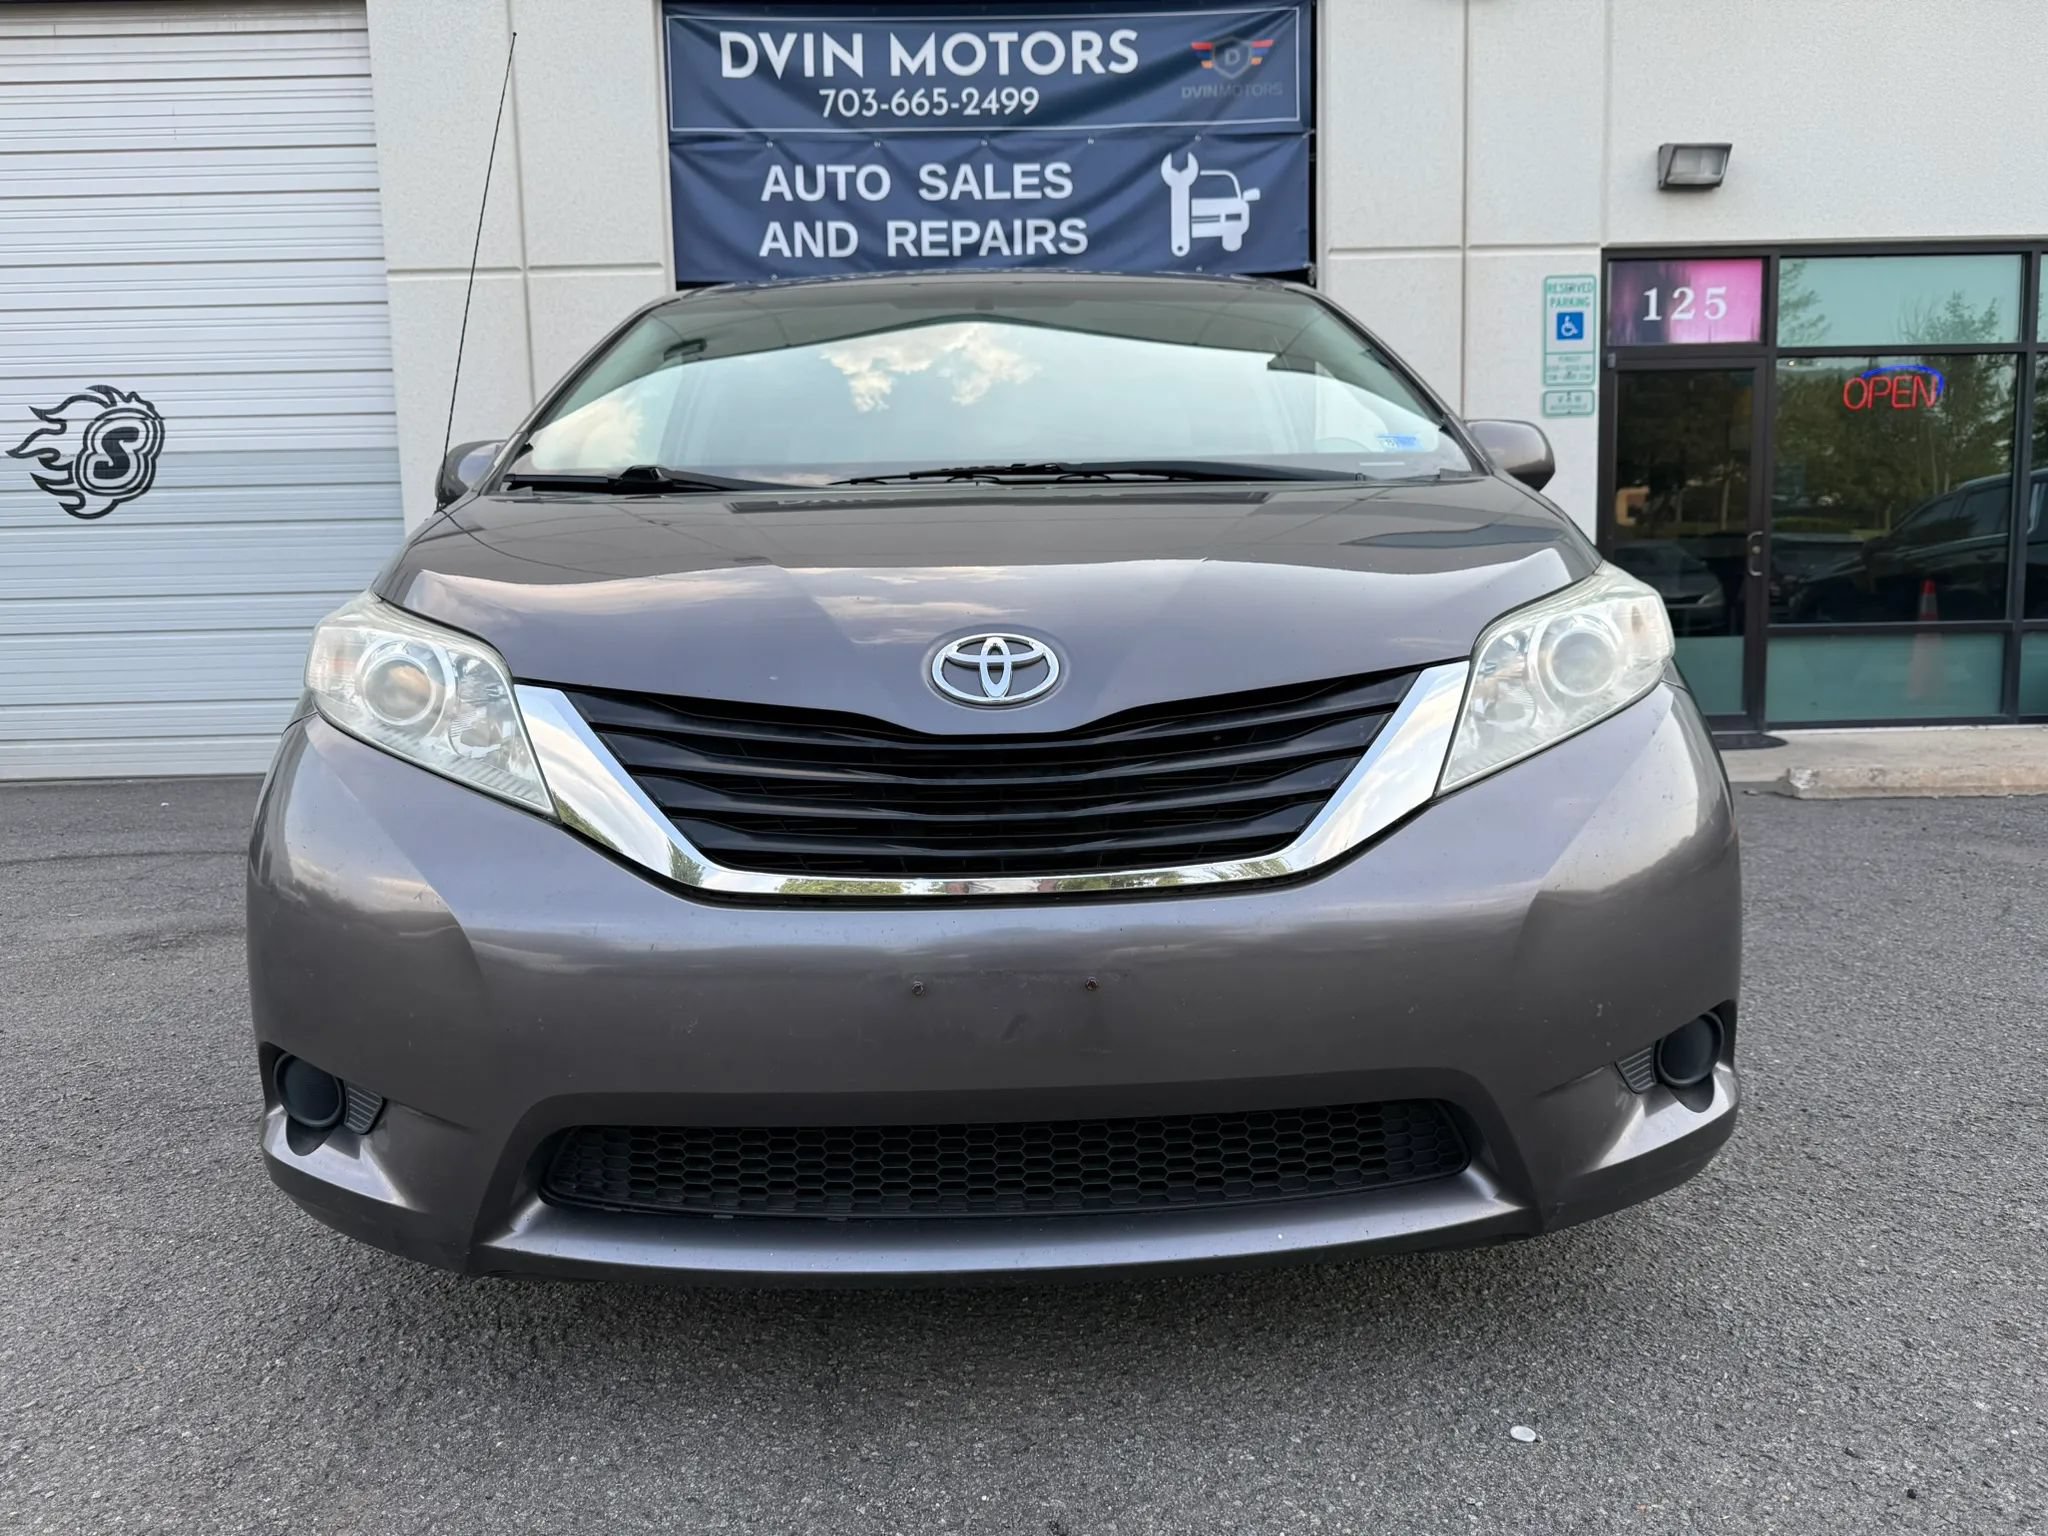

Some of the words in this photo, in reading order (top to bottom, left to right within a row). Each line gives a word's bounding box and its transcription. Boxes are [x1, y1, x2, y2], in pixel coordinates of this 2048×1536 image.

[719, 31, 864, 80] DVIN
[890, 28, 1139, 77] MOTORS
[819, 87, 1040, 118] 703-665-2499
[760, 164, 892, 202] AUTO
[918, 162, 1074, 201] SALES
[759, 220, 859, 258] AND
[886, 217, 1089, 257] REPAIRS
[1642, 286, 1728, 321] 125
[1843, 374, 1938, 412] OPEN
